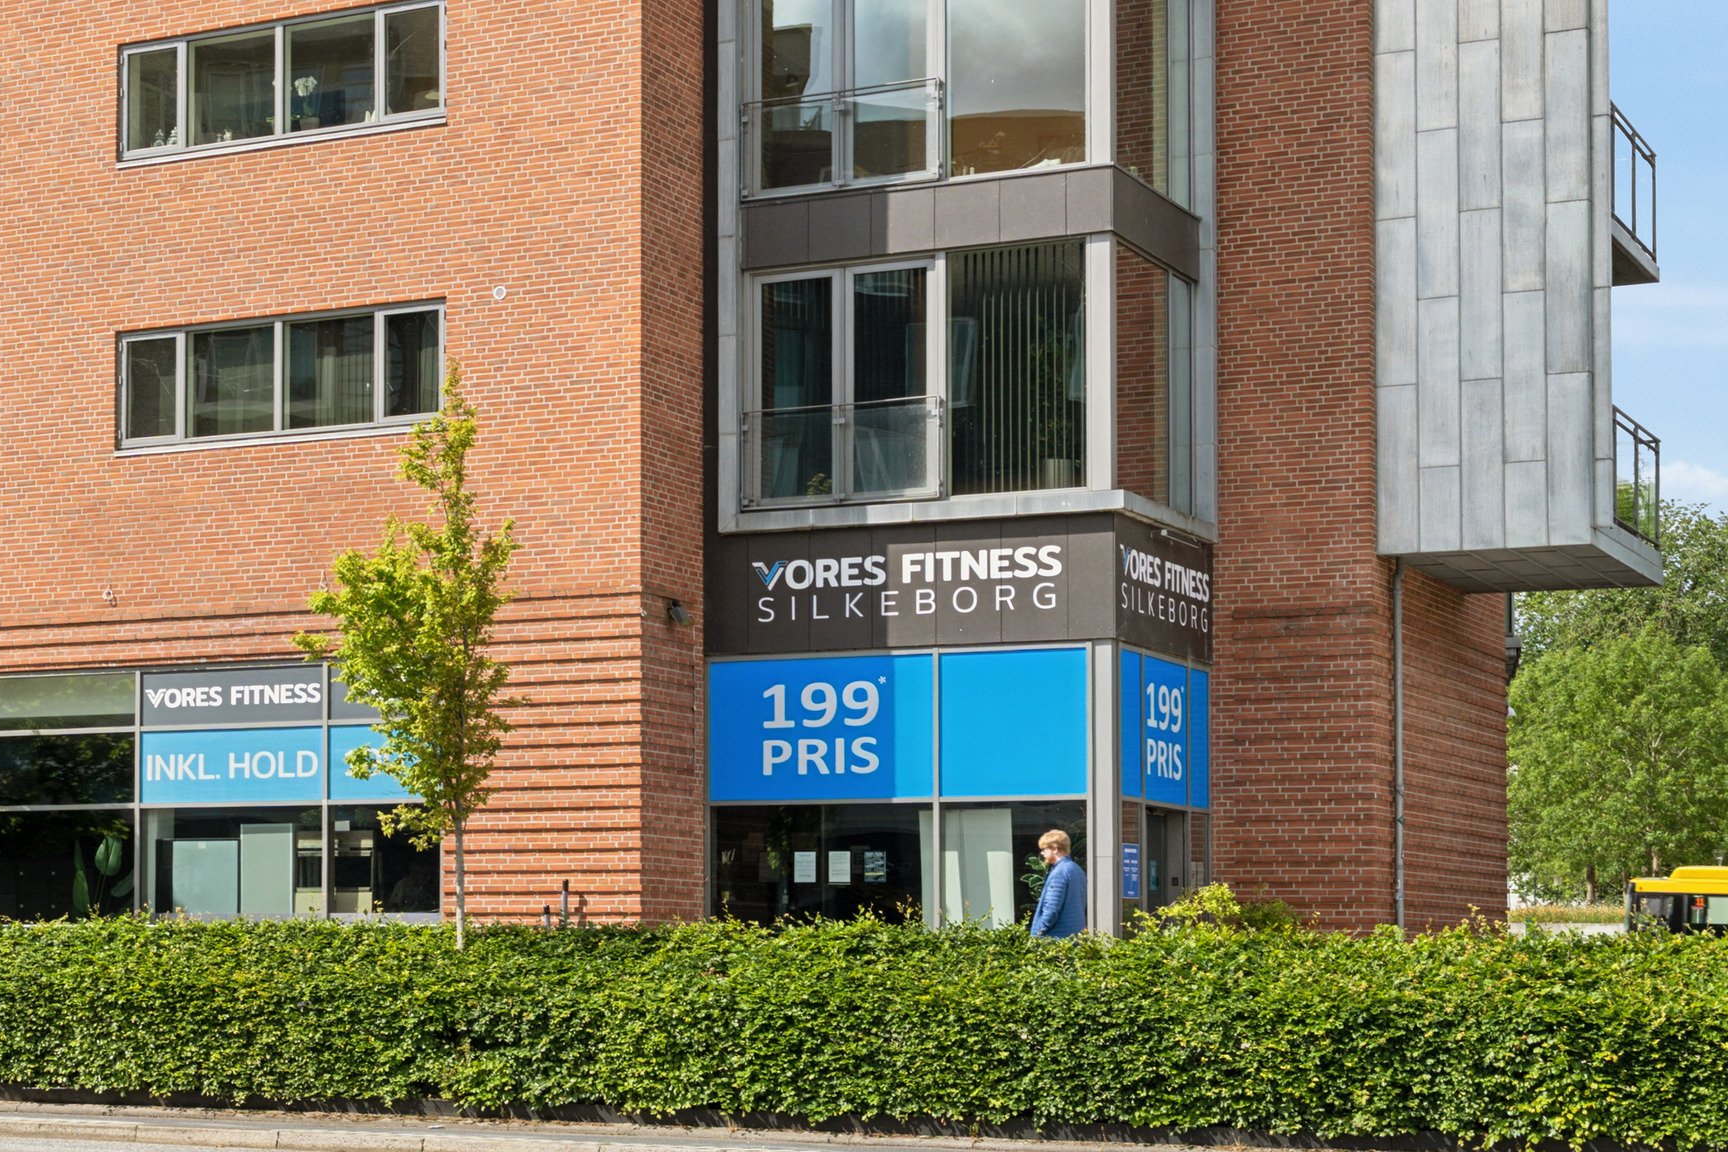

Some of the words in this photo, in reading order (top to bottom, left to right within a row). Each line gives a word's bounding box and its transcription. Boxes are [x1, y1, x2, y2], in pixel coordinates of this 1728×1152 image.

[752, 555, 887, 591] VORES
[902, 545, 1063, 584] FITNESS
[1119, 543, 1161, 587] VORES
[1165, 561, 1210, 603] FITNESS
[757, 582, 1057, 623] SILKEBORG
[1121, 582, 1208, 633] SILKEBORG
[145, 686, 223, 708] VORES
[230, 682, 322, 705] FITNESS
[146, 752, 221, 782] INKL.
[228, 750, 319, 779] HOLD
[762, 736, 880, 776] PRIS
[1146, 738, 1182, 781] PRIS
